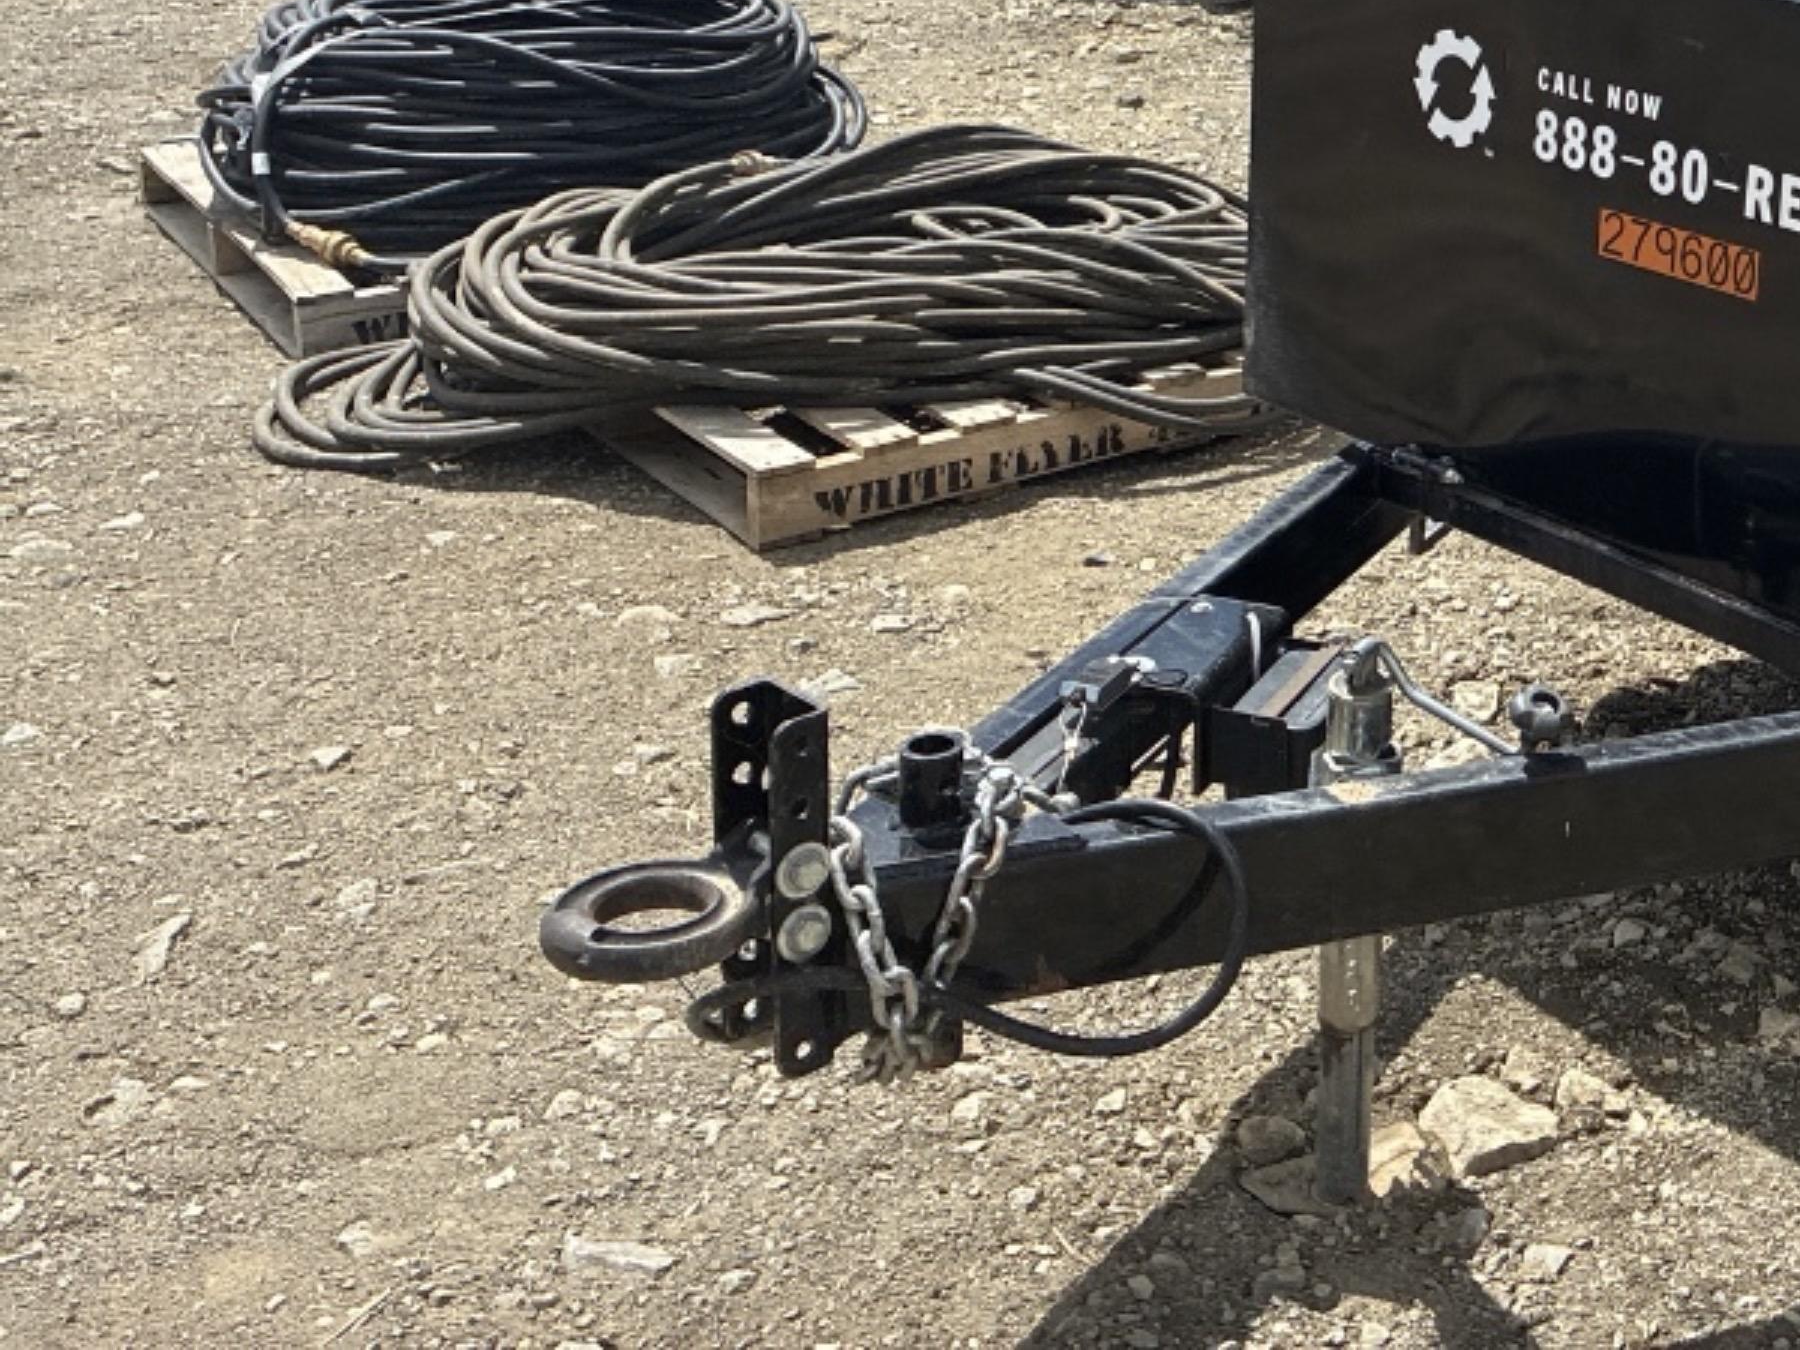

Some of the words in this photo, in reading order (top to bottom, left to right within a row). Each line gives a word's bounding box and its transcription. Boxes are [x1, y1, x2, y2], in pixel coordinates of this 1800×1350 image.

[1537, 66, 1594, 105] CALL
[1607, 83, 1664, 122] NOW
[1602, 211, 1758, 295] 279600
[815, 457, 973, 518] WHITE
